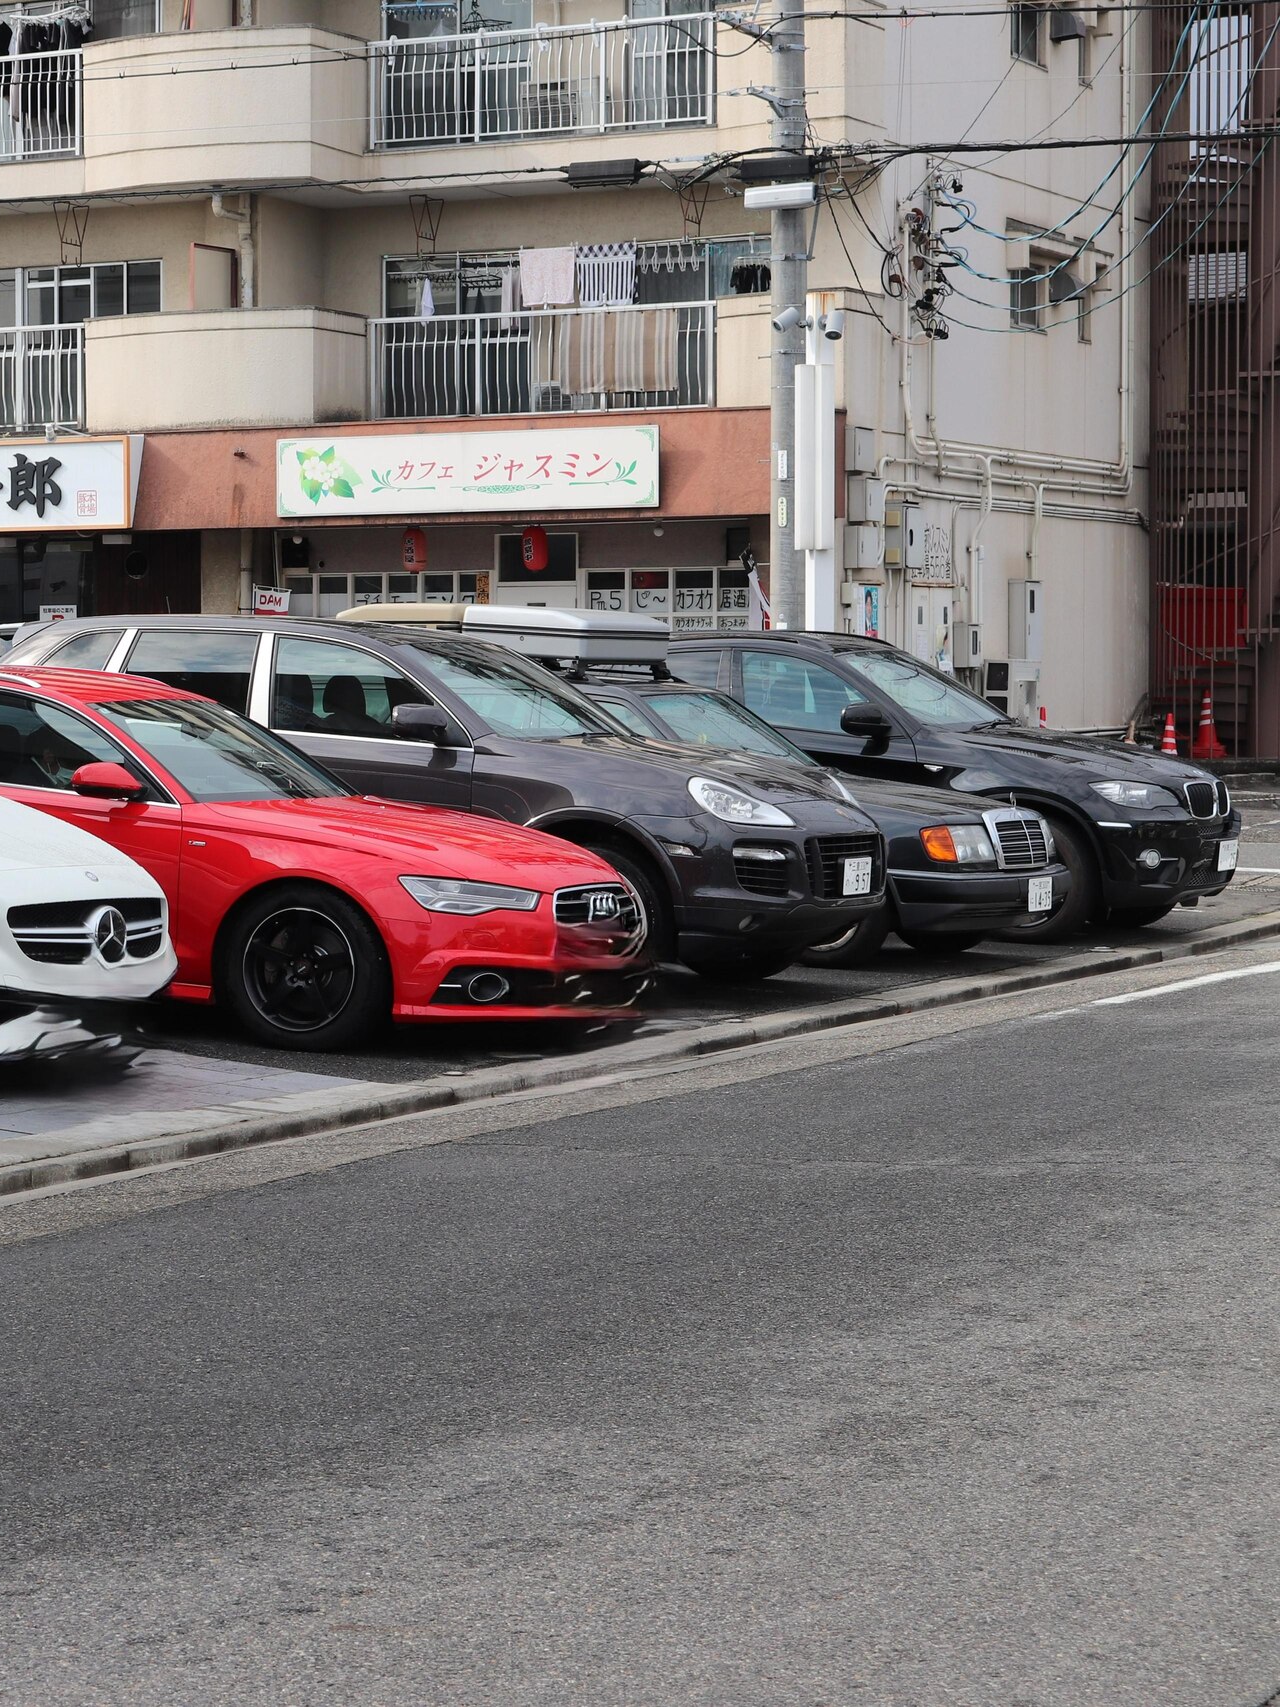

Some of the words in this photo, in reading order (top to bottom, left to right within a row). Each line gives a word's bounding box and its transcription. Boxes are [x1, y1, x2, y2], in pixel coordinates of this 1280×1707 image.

[394, 460, 455, 481] カフェ
[473, 453, 613, 483] ジャスミン
[259, 594, 282, 607] DAM
[676, 590, 713, 610] カラオケ
[720, 589, 749, 609] 居酒
